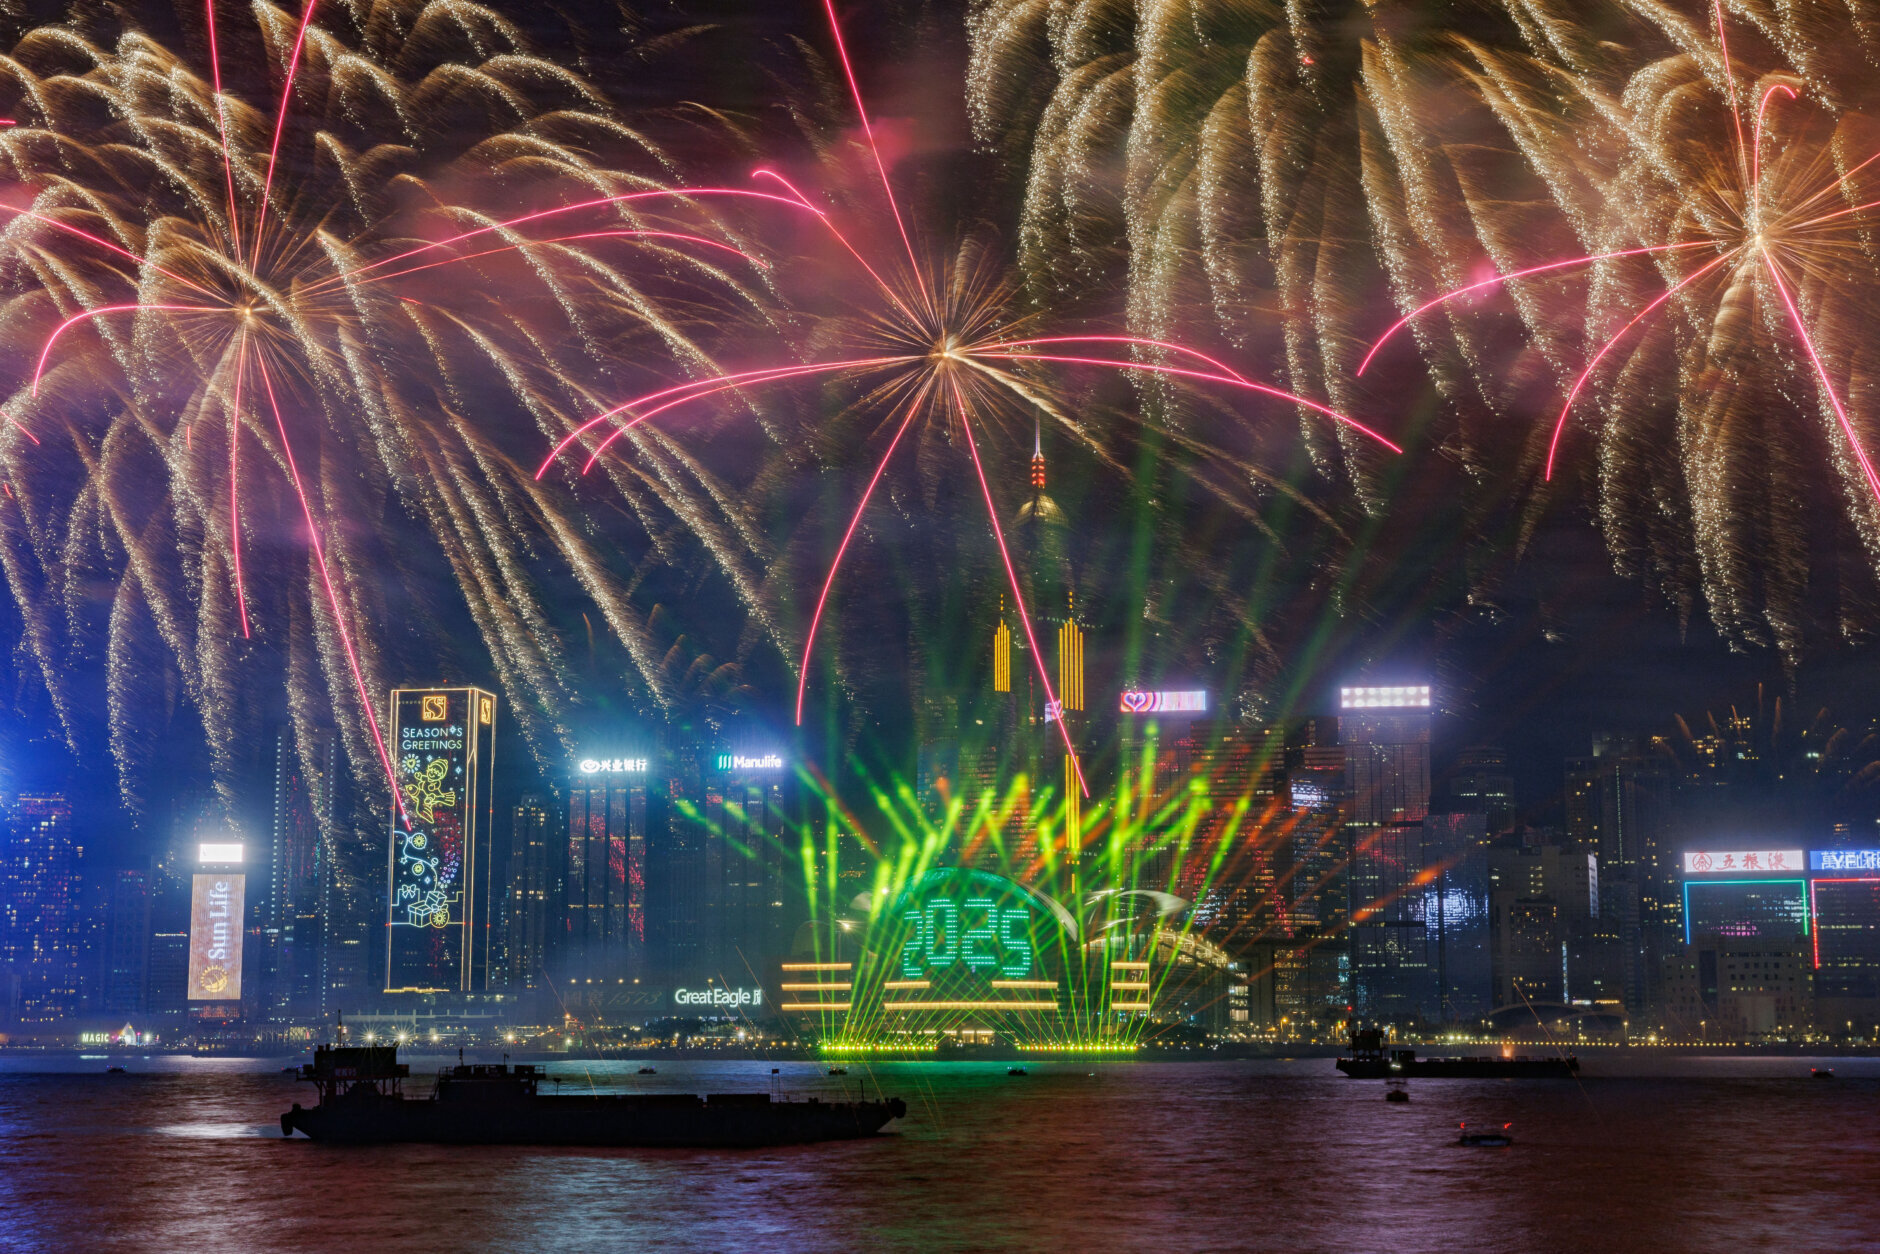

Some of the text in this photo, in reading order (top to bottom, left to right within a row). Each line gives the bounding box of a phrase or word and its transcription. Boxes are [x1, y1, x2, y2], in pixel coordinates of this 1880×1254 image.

[402, 739, 462, 750] GREETINGS
[600, 759, 648, 772] 兴业银行
[733, 754, 782, 769] Manulife
[208, 880, 228, 960] Sun Life
[903, 898, 1031, 976] 2025
[674, 987, 751, 1008] Great Eagle
[82, 1033, 110, 1042] MAGIC
